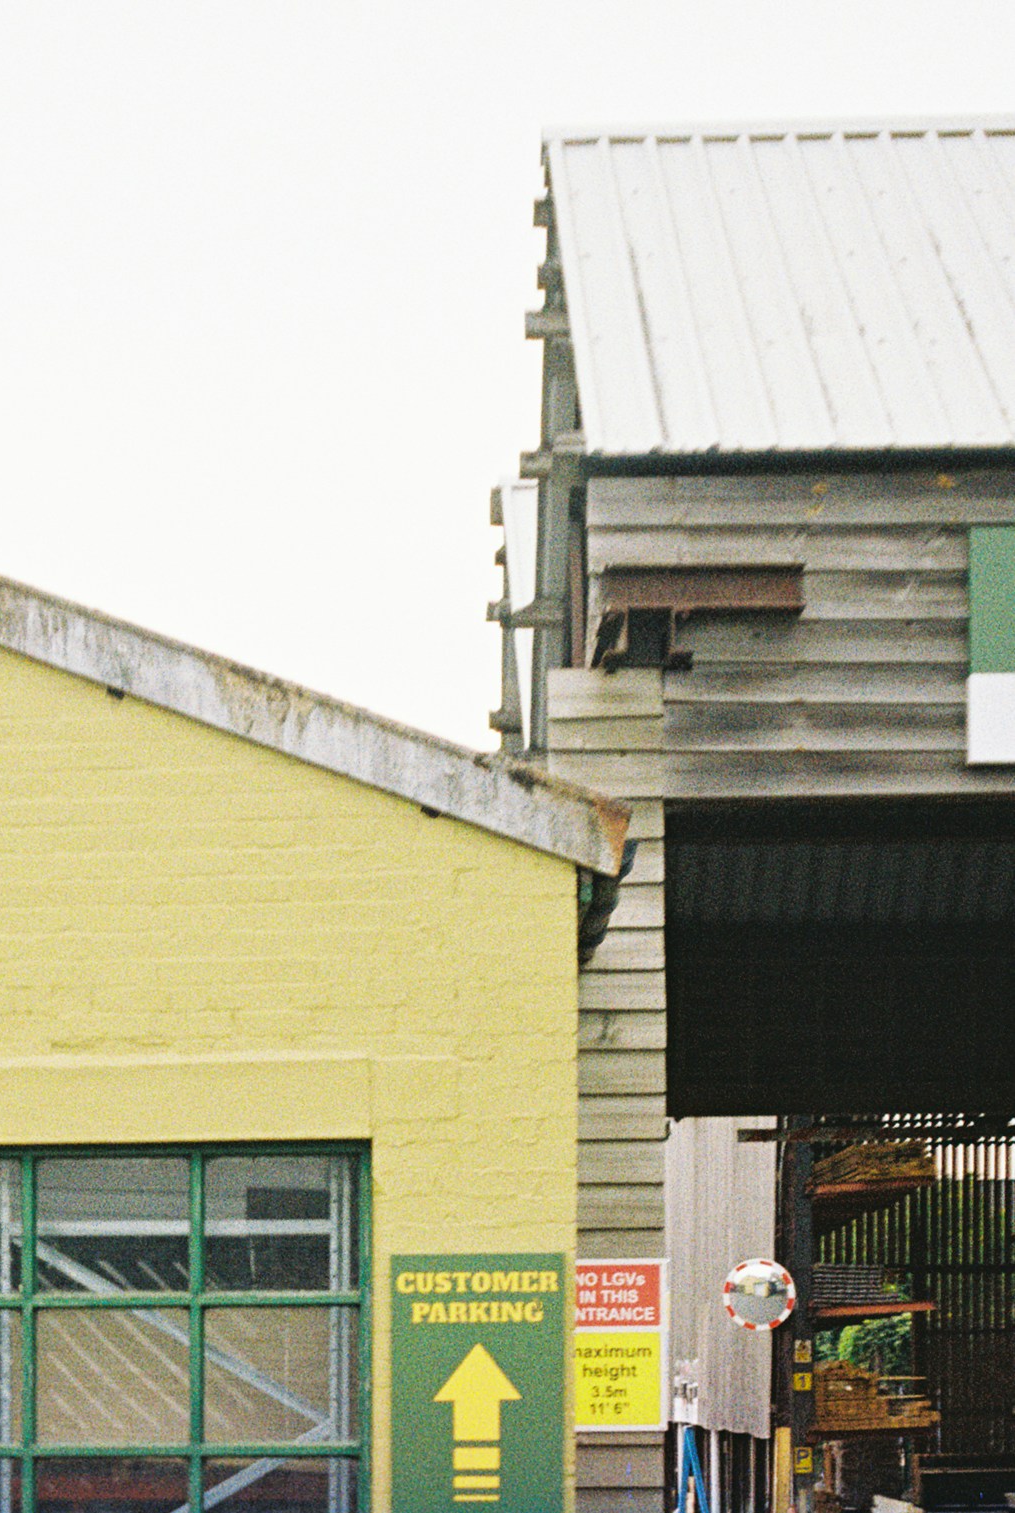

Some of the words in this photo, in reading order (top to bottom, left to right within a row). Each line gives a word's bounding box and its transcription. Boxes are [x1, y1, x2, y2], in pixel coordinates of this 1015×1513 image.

[396, 1271, 559, 1294] CUSTOMER
[576, 1272, 598, 1286] NO
[601, 1272, 646, 1286] LGVs
[579, 1290, 597, 1304] IN
[600, 1289, 639, 1303] THIS
[411, 1299, 544, 1324] PARKING
[575, 1306, 655, 1321] NTRANCE
[582, 1363, 637, 1380] height
[591, 1385, 627, 1398] 3.5m
